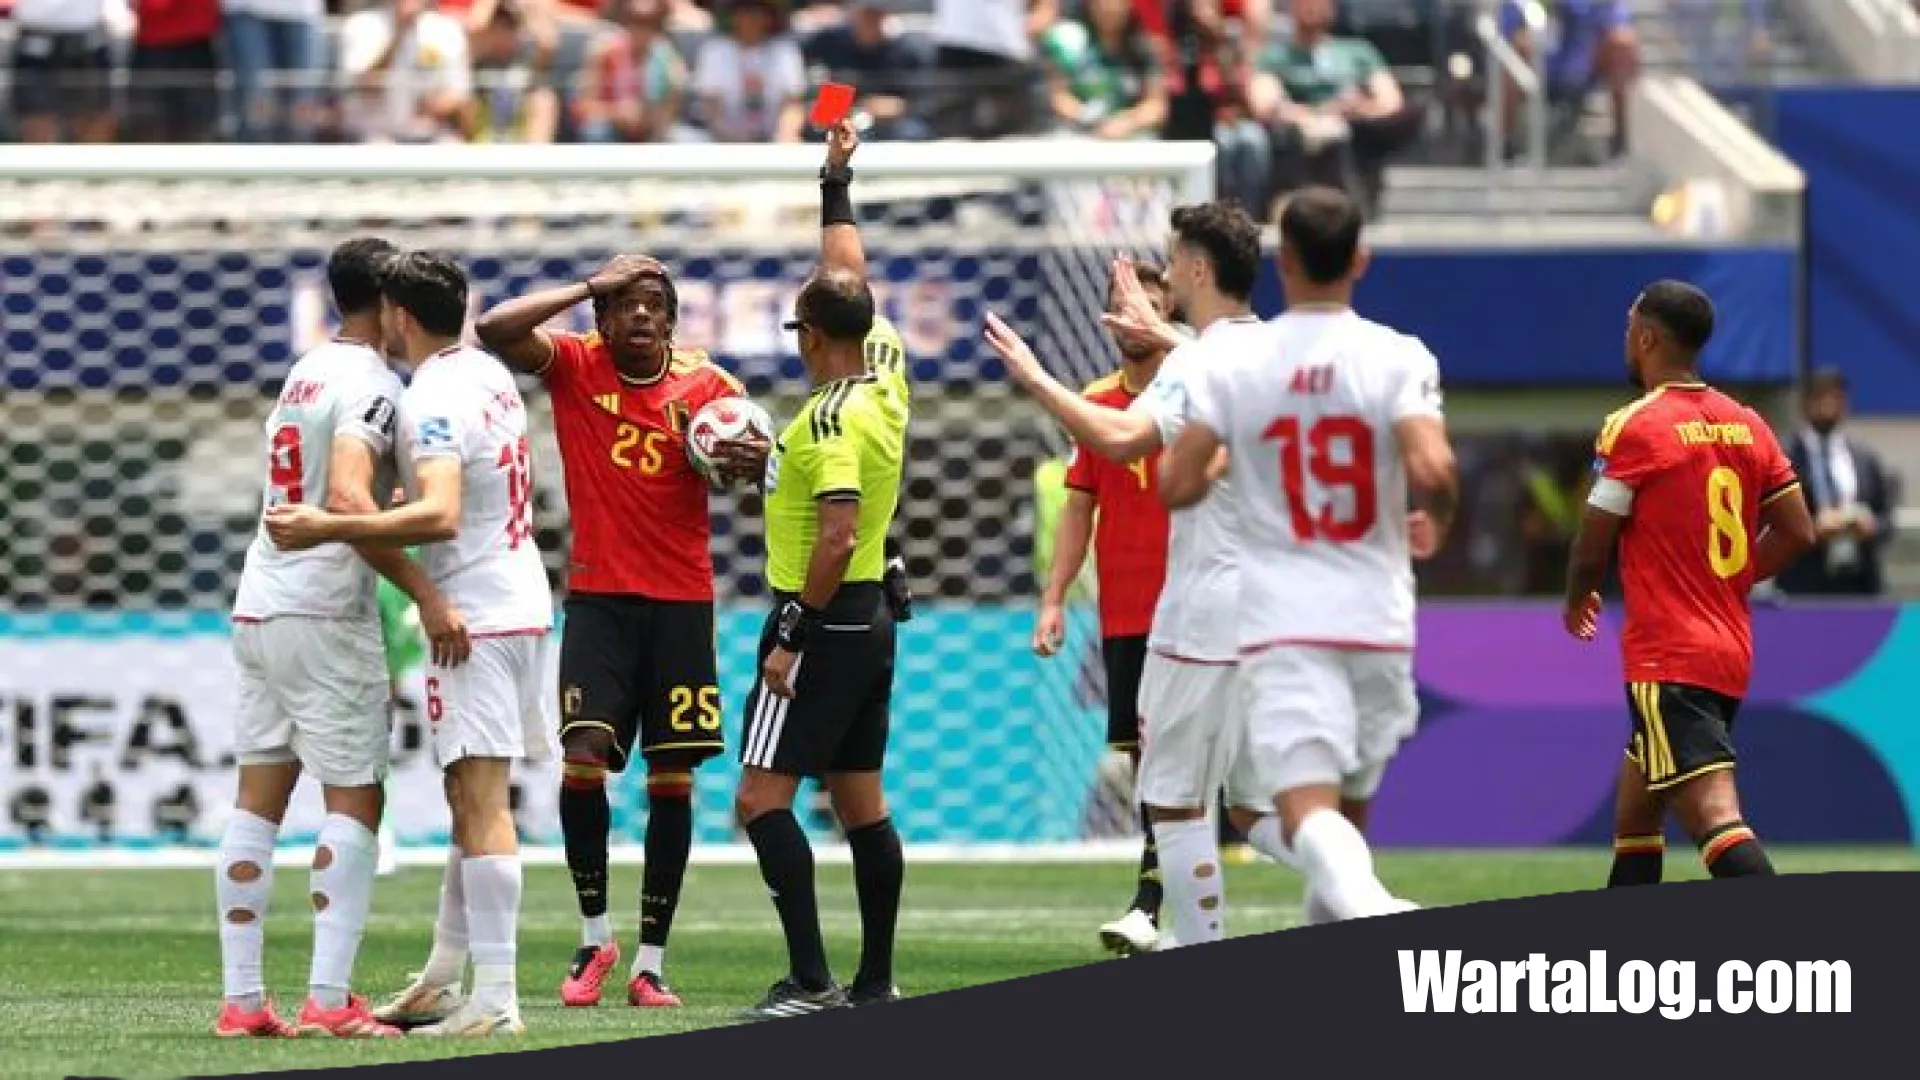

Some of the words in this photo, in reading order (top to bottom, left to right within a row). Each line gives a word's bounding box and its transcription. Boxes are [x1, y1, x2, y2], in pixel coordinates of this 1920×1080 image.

[611, 423, 668, 474] 25
[1259, 415, 1376, 542] 19
[1707, 466, 1748, 578] 8
[670, 685, 720, 731] 25
